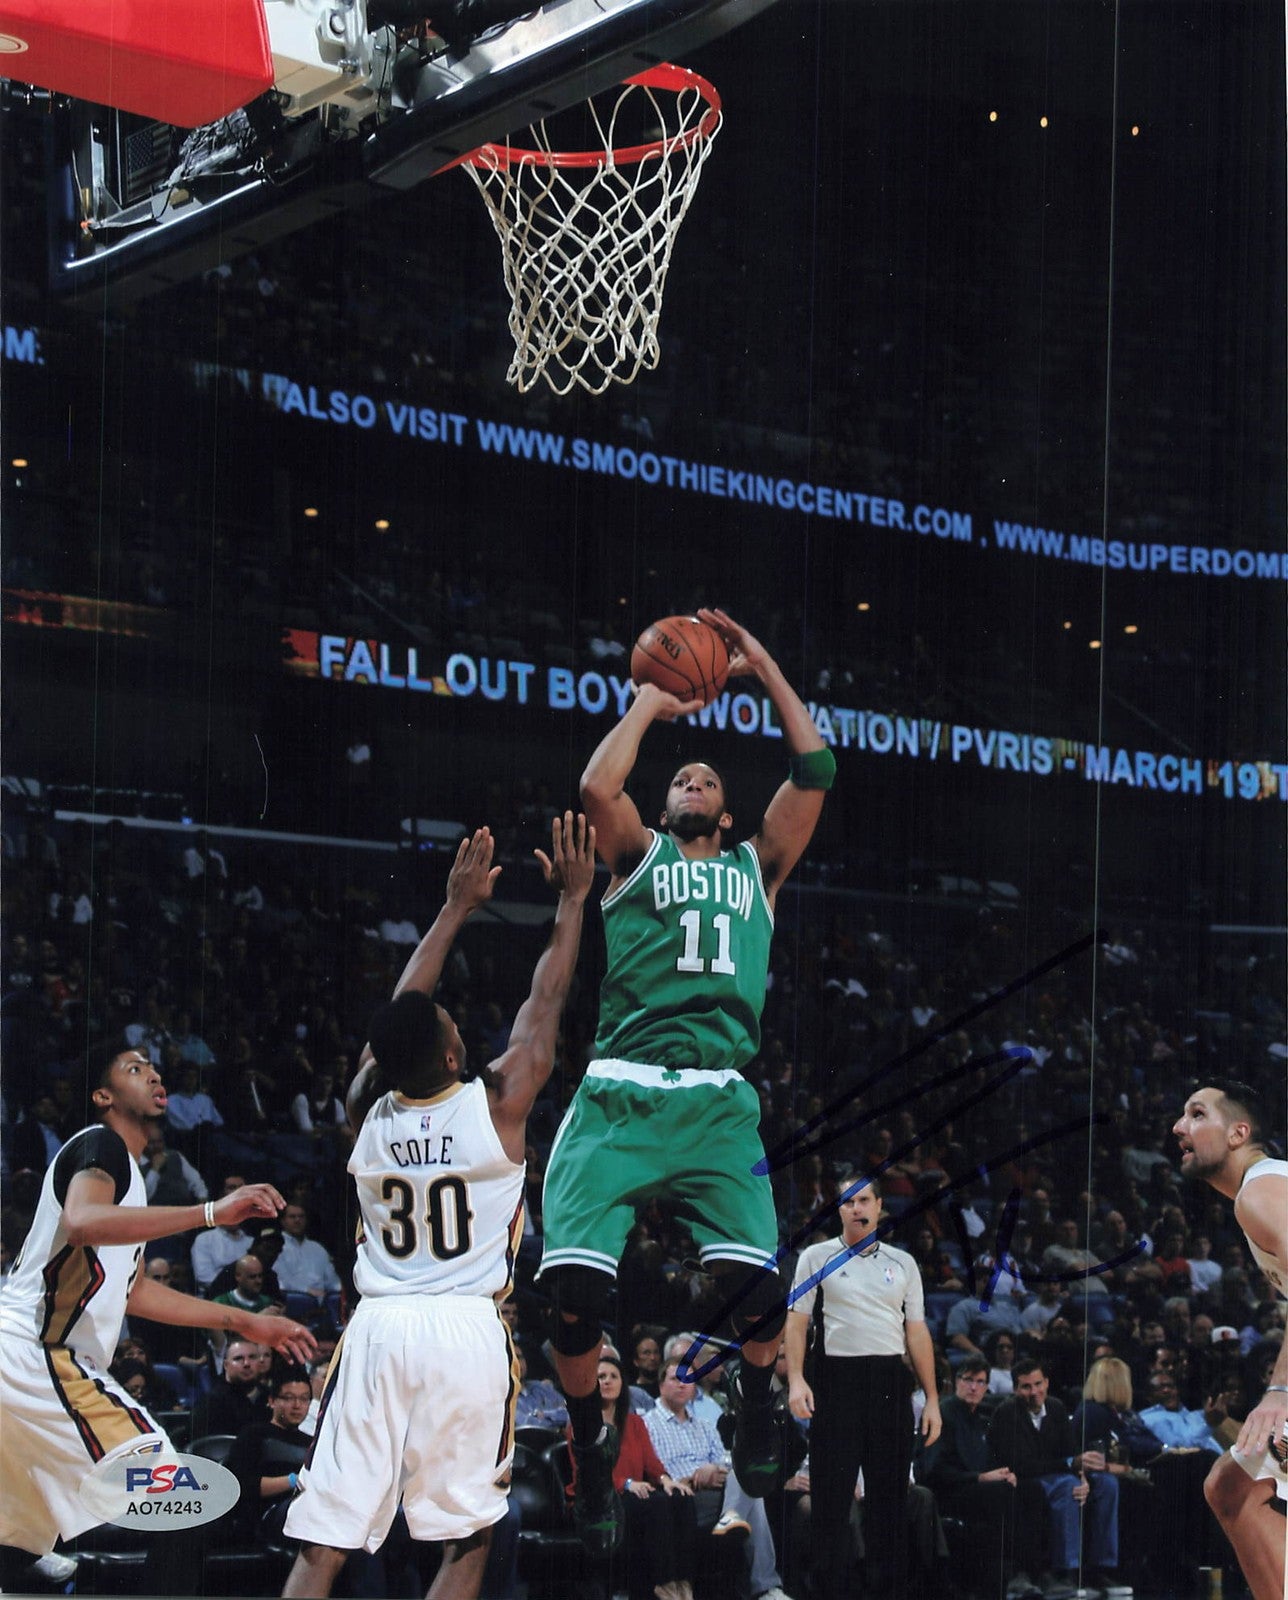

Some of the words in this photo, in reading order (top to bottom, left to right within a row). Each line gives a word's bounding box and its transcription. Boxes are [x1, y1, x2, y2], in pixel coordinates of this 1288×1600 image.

[385, 400, 468, 447] VISIT
[476, 418, 973, 542] WWW.SMOOTHIEKINGCENTER.COM
[319, 634, 433, 692] FALL
[445, 652, 535, 704] OUT
[547, 667, 632, 717] BOY
[951, 724, 1053, 775] PVRIS
[1084, 744, 1203, 795] MARCH
[652, 860, 755, 922] BOSTON
[677, 909, 736, 976] 11
[389, 1135, 453, 1168] COLE
[379, 1173, 475, 1261] 30
